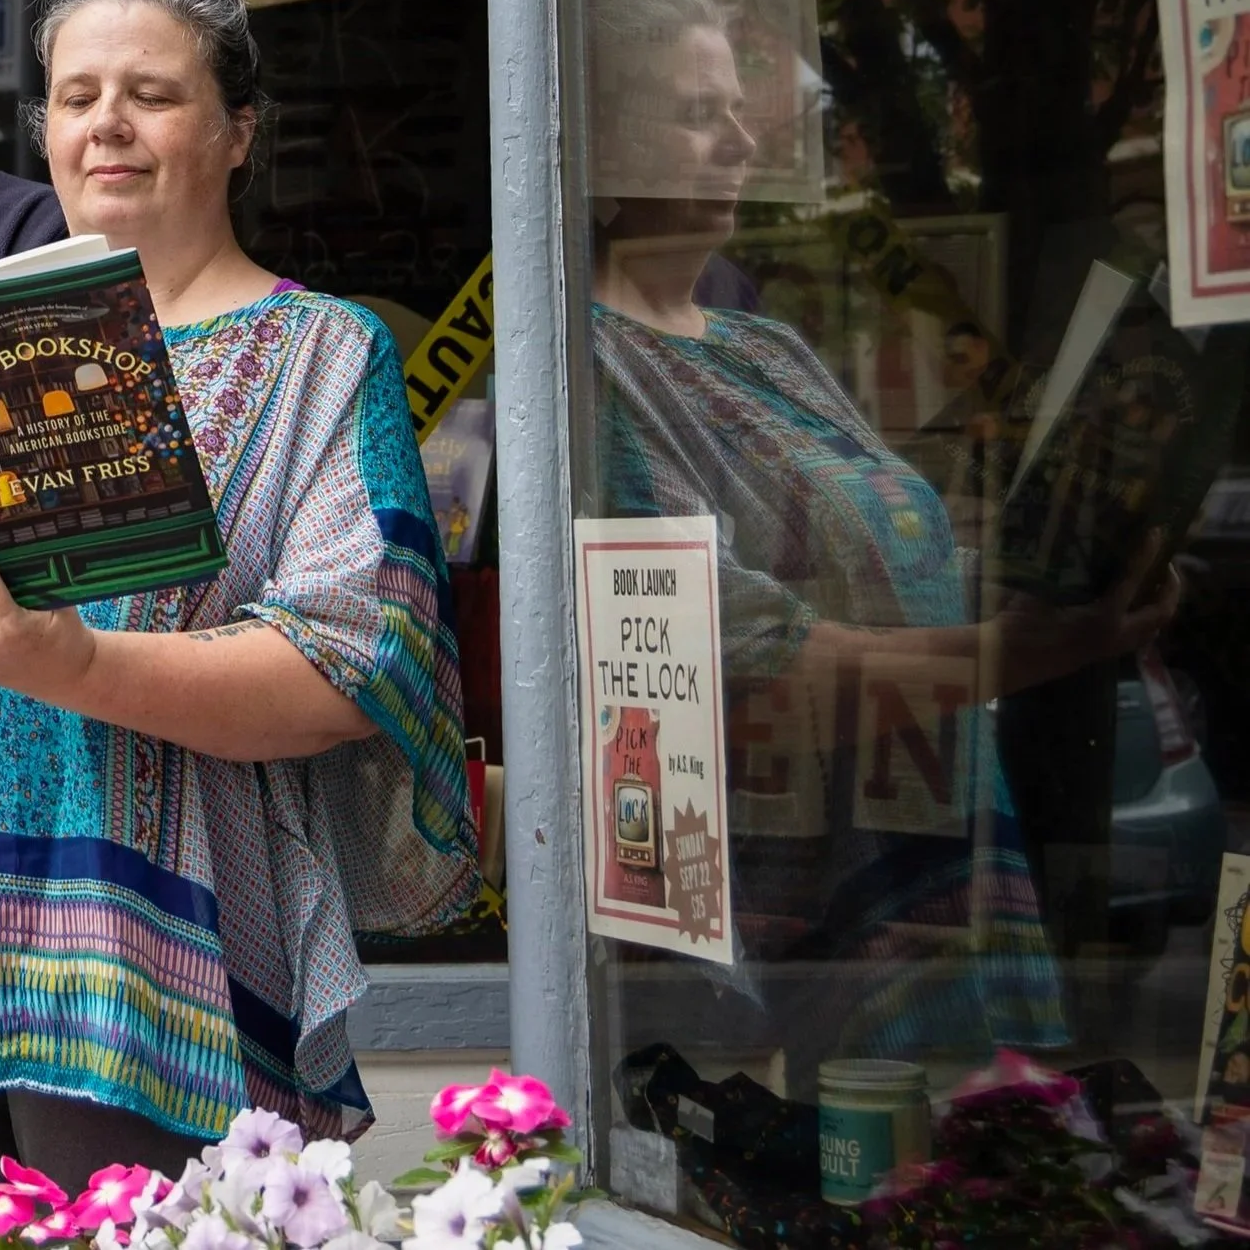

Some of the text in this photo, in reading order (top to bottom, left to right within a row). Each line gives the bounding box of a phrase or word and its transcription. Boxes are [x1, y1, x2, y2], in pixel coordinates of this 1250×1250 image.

[17, 409, 111, 438] A HISTORY OF THE
[9, 422, 127, 455] AMERICAN BOOKSTORE
[9, 455, 151, 497] EVAN FRISS
[613, 569, 677, 597] BOOK LAUNCH
[621, 617, 671, 656] PICK
[598, 661, 700, 705] THE LOCK
[615, 727, 648, 753] PICK
[622, 754, 642, 776] THE
[668, 753, 705, 780] by A.S. King
[618, 798, 648, 825] LOCK
[676, 830, 707, 861] SUNDAY
[679, 863, 698, 892] SEPT
[698, 861, 712, 888] 22
[691, 893, 707, 922] $25
[819, 1133, 861, 1156] OUNG
[820, 1153, 860, 1177] DULT
